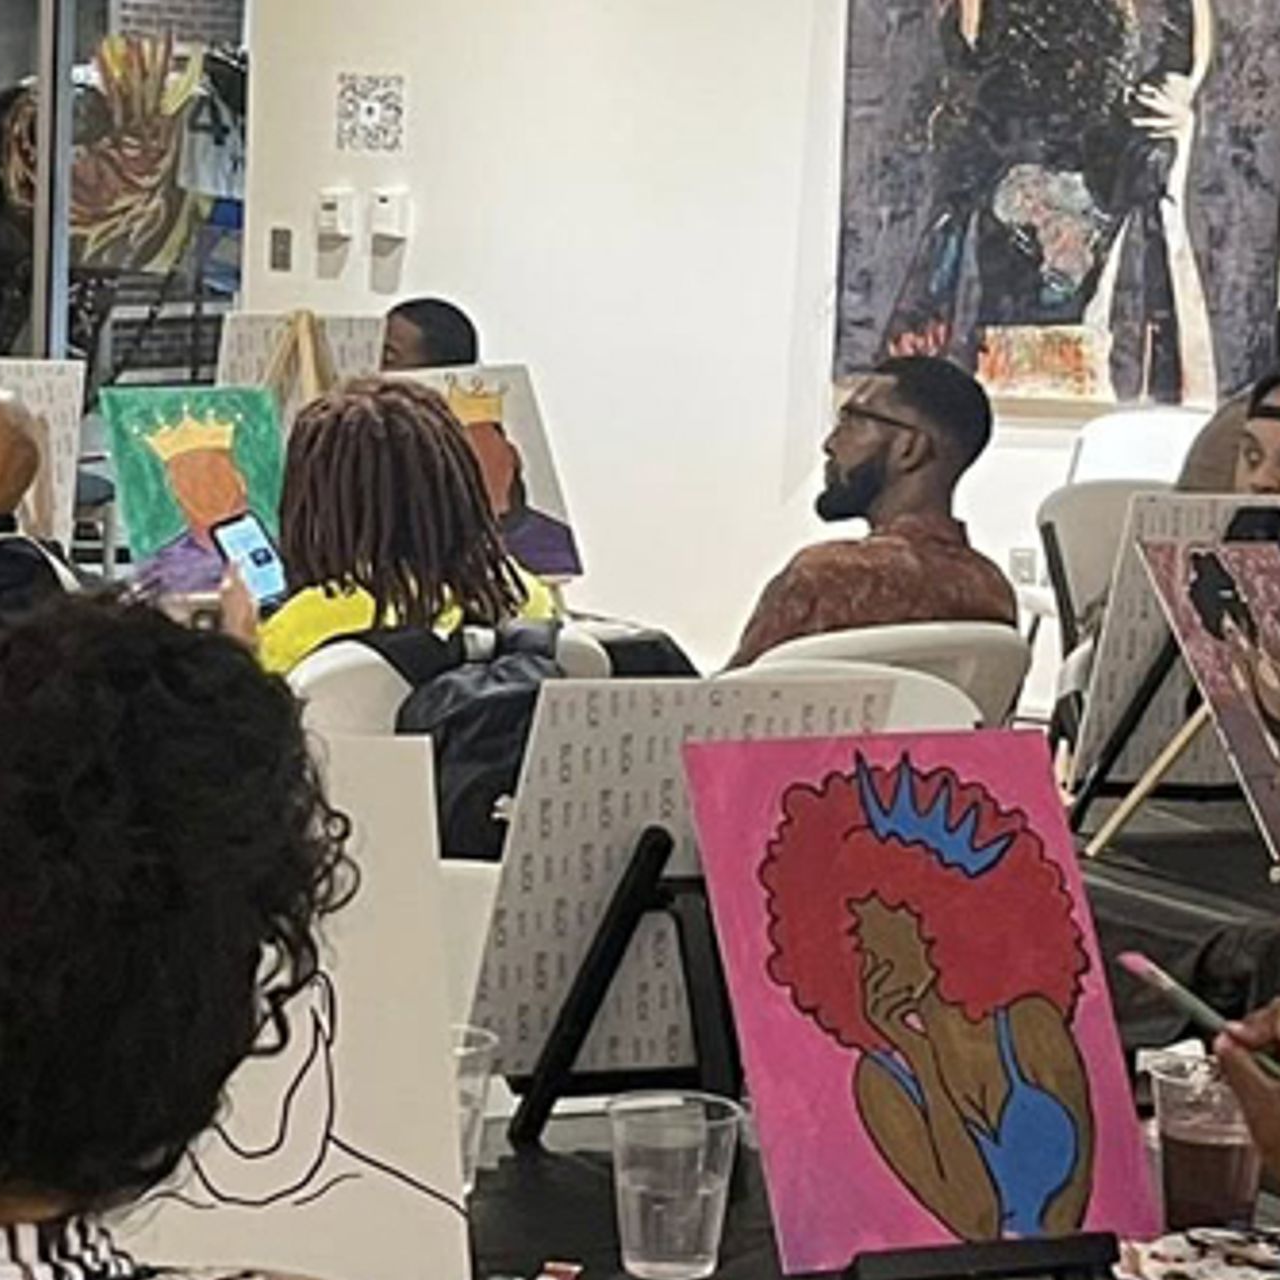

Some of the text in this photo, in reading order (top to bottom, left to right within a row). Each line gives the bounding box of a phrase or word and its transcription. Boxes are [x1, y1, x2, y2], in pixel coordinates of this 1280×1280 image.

[560, 743, 573, 784] BLICK
[540, 798, 552, 839] BLICK
[600, 788, 613, 829] BLICK
[522, 852, 533, 893] BLICK
